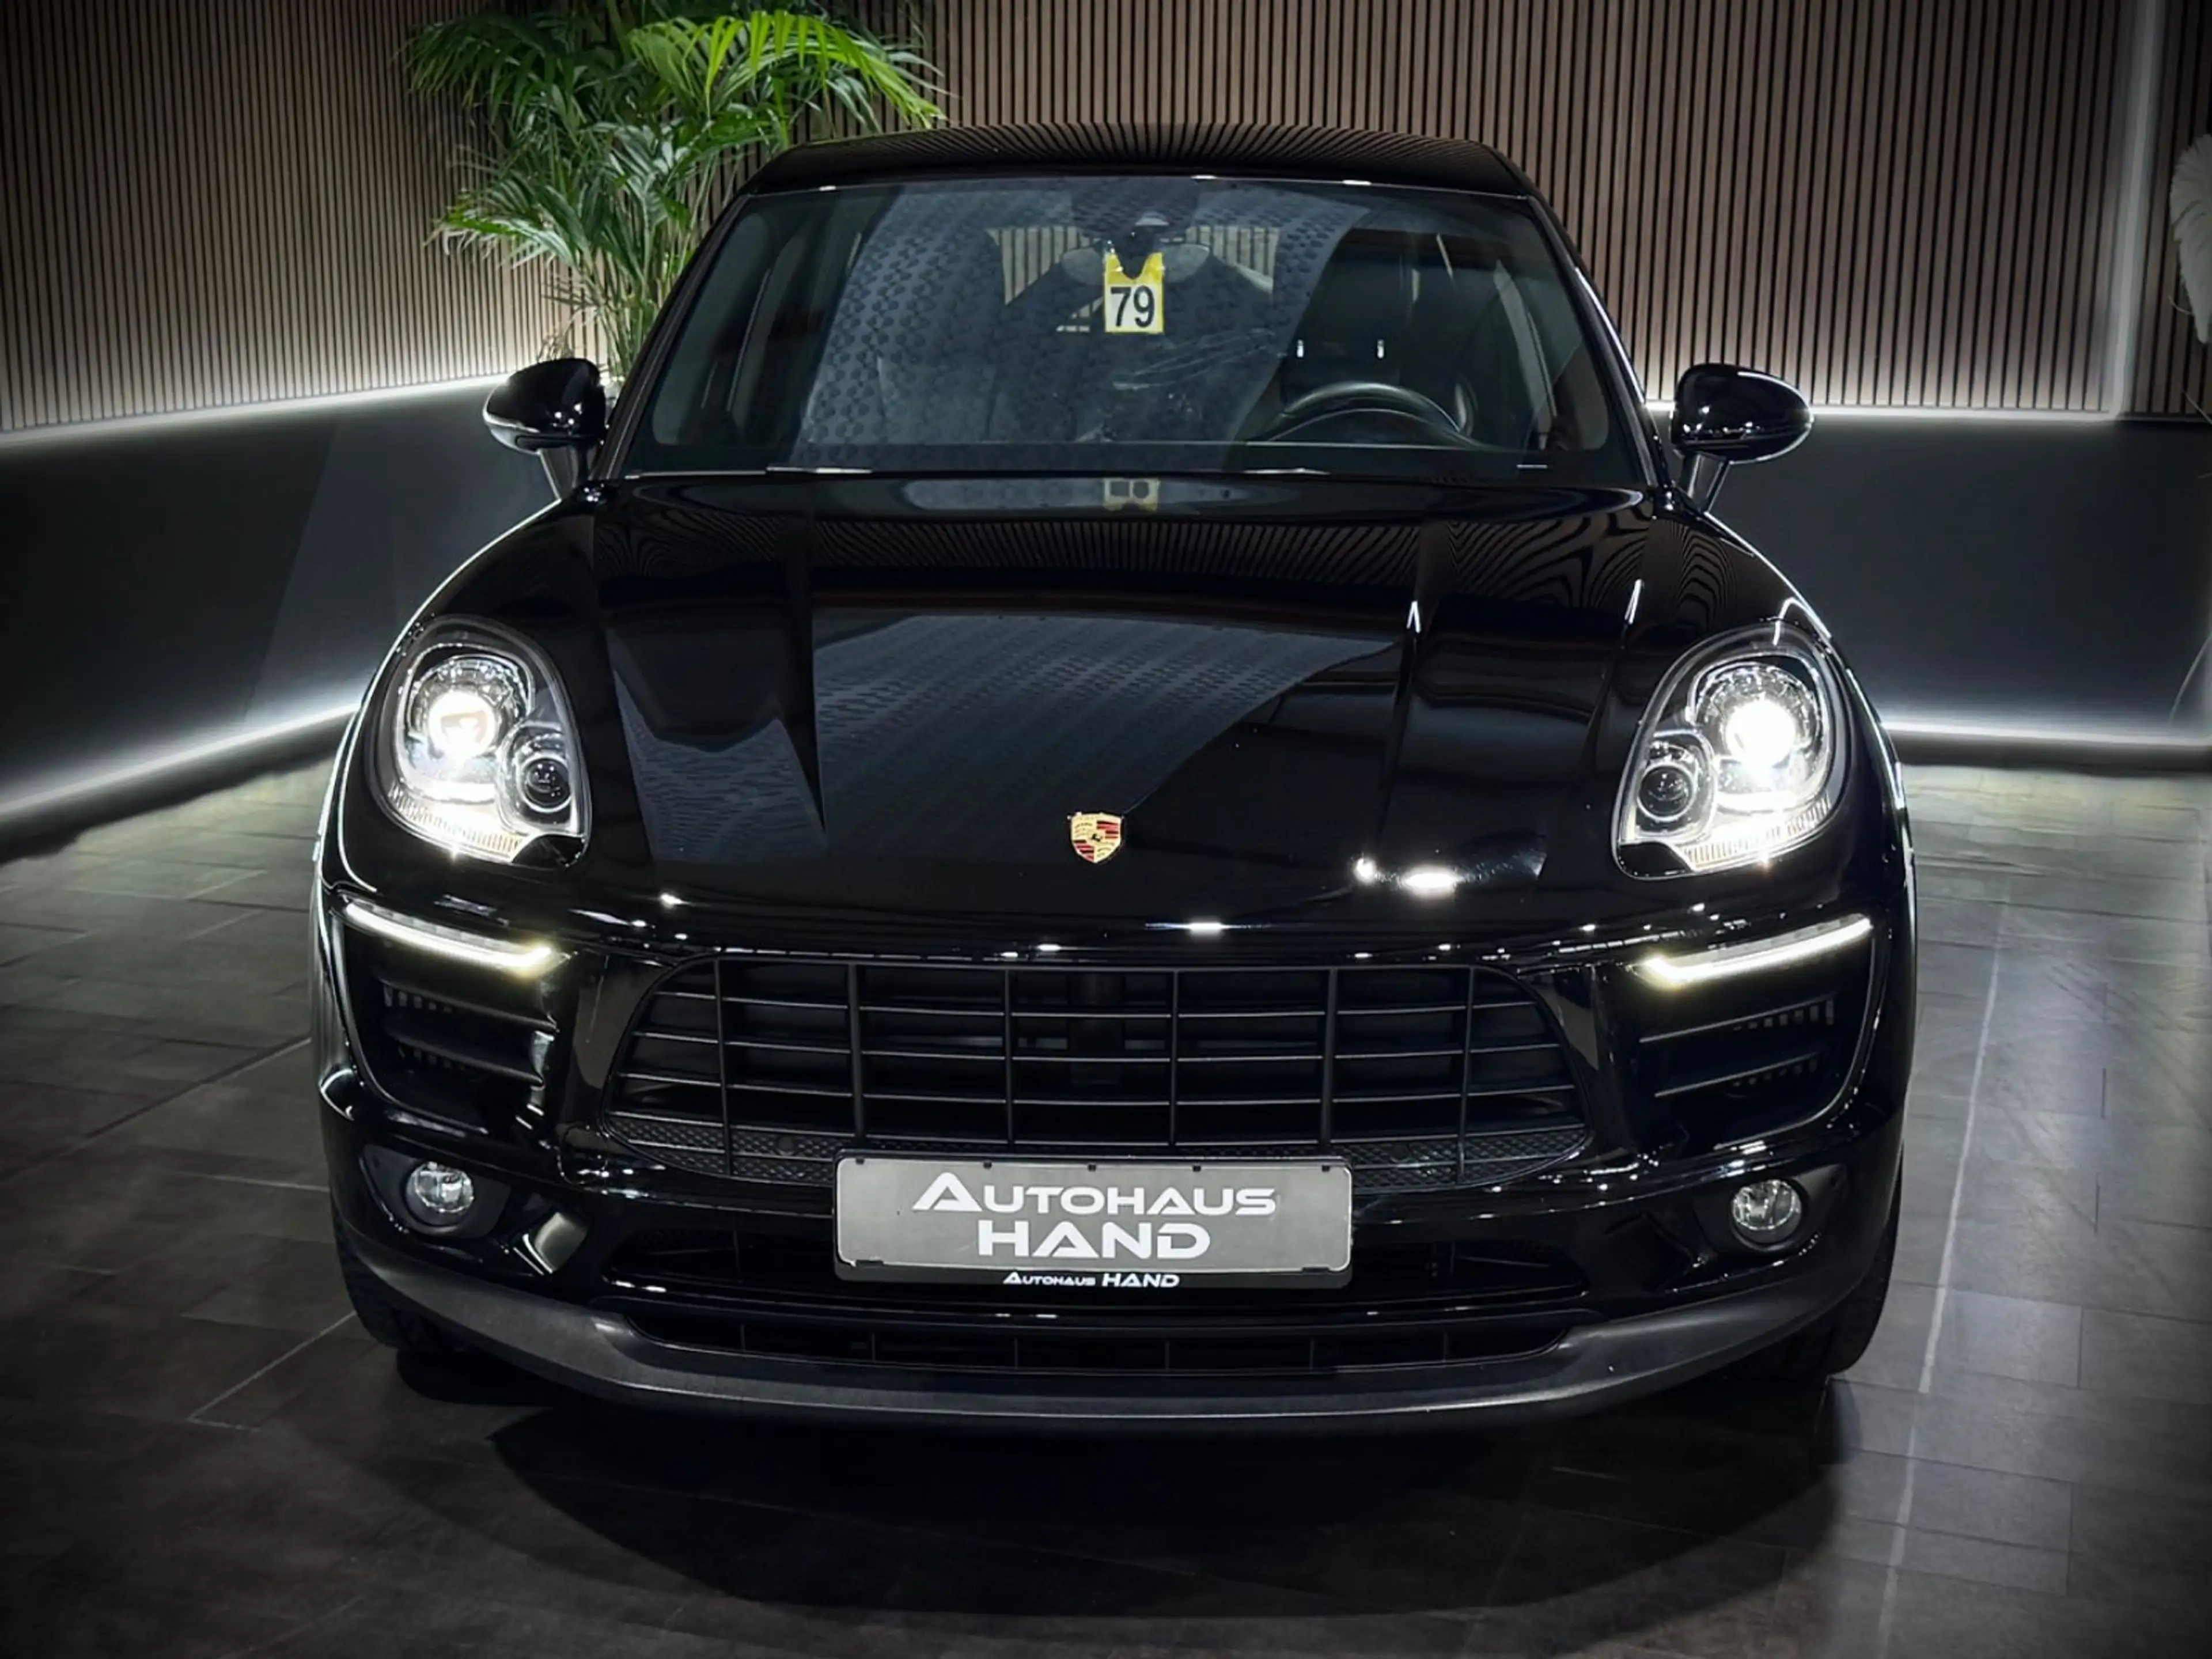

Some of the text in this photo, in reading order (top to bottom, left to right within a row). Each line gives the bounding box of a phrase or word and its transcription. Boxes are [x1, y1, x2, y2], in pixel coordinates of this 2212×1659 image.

[1111, 285, 1155, 328] 79
[912, 1172, 1276, 1215] AUTOHAUS
[978, 1219, 1210, 1259] HAND
[1003, 1271, 1180, 1287] AUTOHAUS HAND
